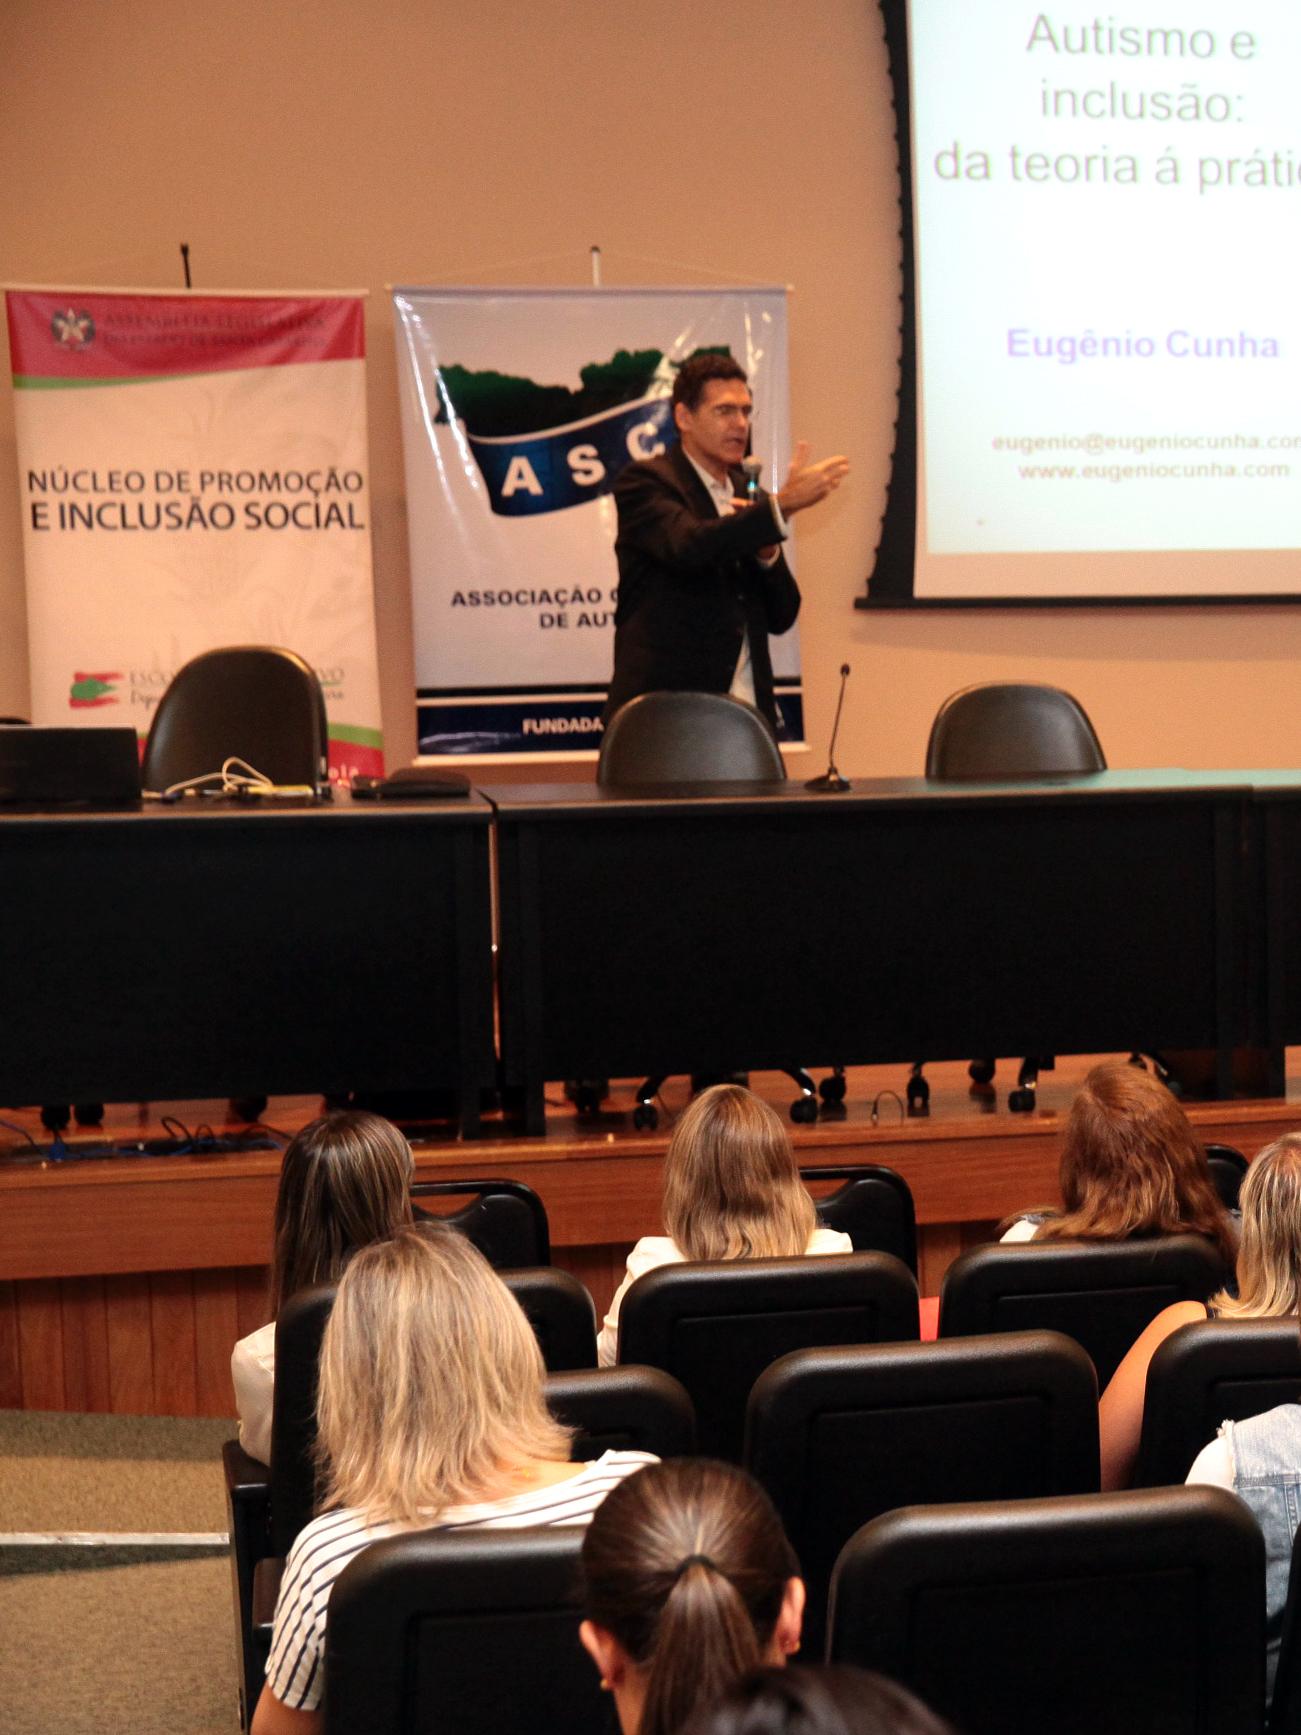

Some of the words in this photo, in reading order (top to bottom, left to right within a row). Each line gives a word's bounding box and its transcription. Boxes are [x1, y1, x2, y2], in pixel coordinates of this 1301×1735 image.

[1027, 13, 1215, 59] Autismo
[1230, 30, 1256, 59] e
[1041, 78, 1244, 122] inclusão:
[934, 141, 991, 181] da
[1010, 144, 1138, 183] teoria
[1155, 146, 1179, 184] á
[1007, 328, 1155, 364] Eugênio
[1166, 330, 1279, 359] Cunha
[29, 466, 145, 494] NÚCLEO
[155, 471, 191, 494] DE
[201, 466, 363, 498] PROMOÇÃO
[1018, 462, 1290, 482] www.eugeniocunha.com
[31, 502, 51, 531] E
[60, 495, 235, 530] INCLUSÃO
[245, 502, 365, 530] SOCIAL
[452, 585, 602, 608] ASSOCIAÇÃO
[540, 612, 569, 629] DE
[523, 717, 604, 735] FUNDADA
